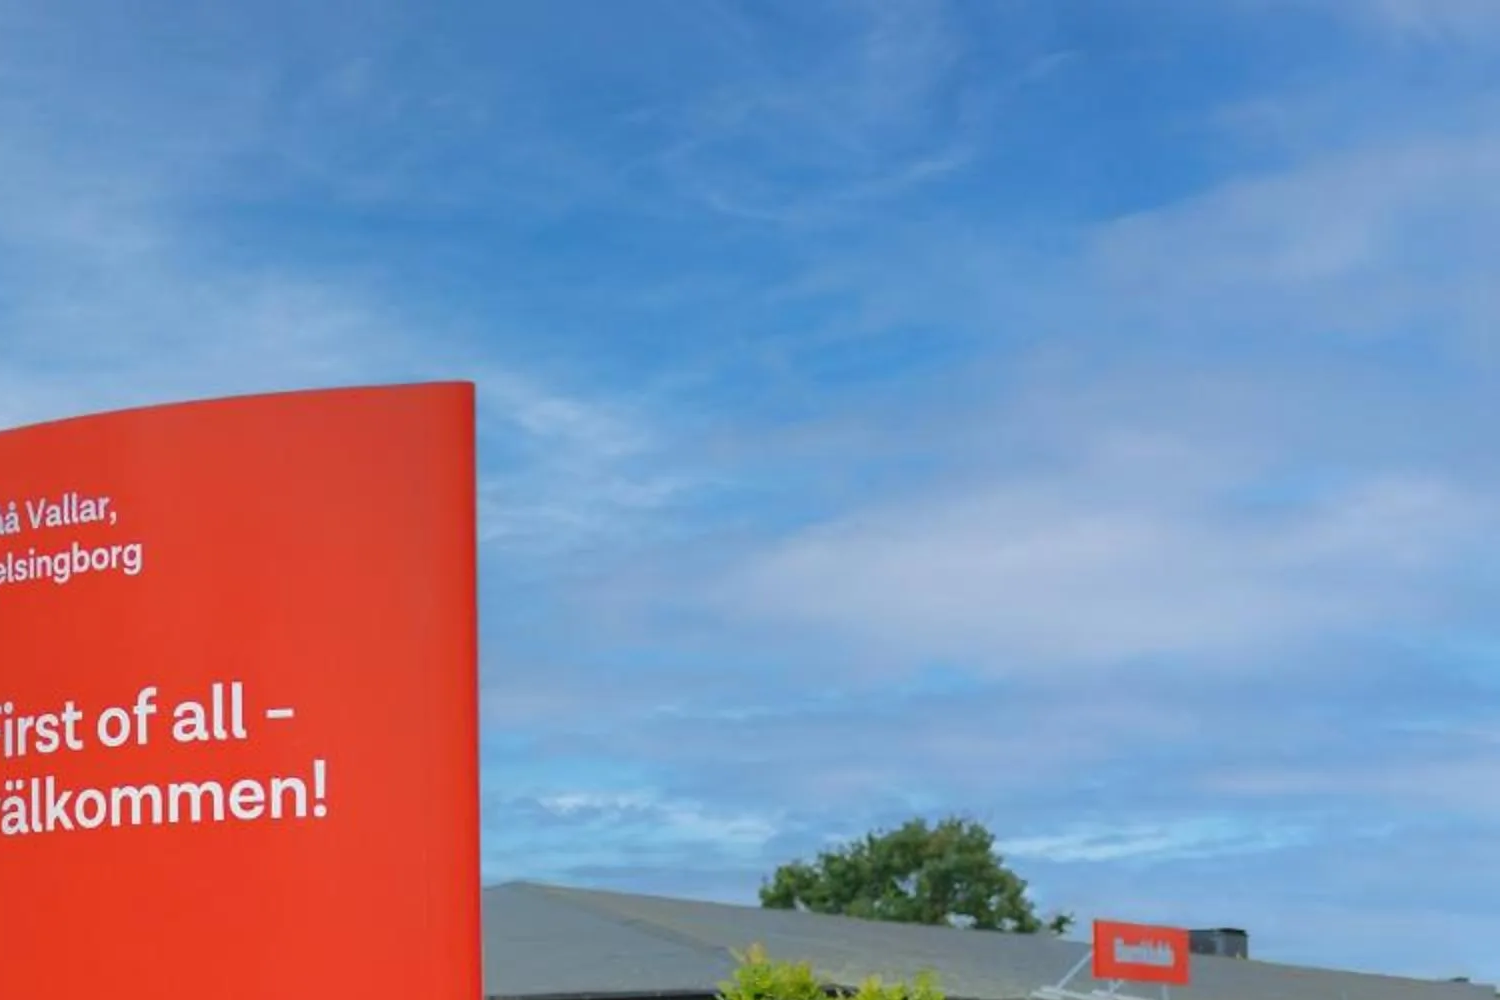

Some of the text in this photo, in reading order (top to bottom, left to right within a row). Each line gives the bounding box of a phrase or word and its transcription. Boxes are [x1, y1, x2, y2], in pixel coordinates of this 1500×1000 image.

[26, 492, 118, 530] Vallar,
[97, 686, 158, 748] of
[172, 681, 248, 743] all
